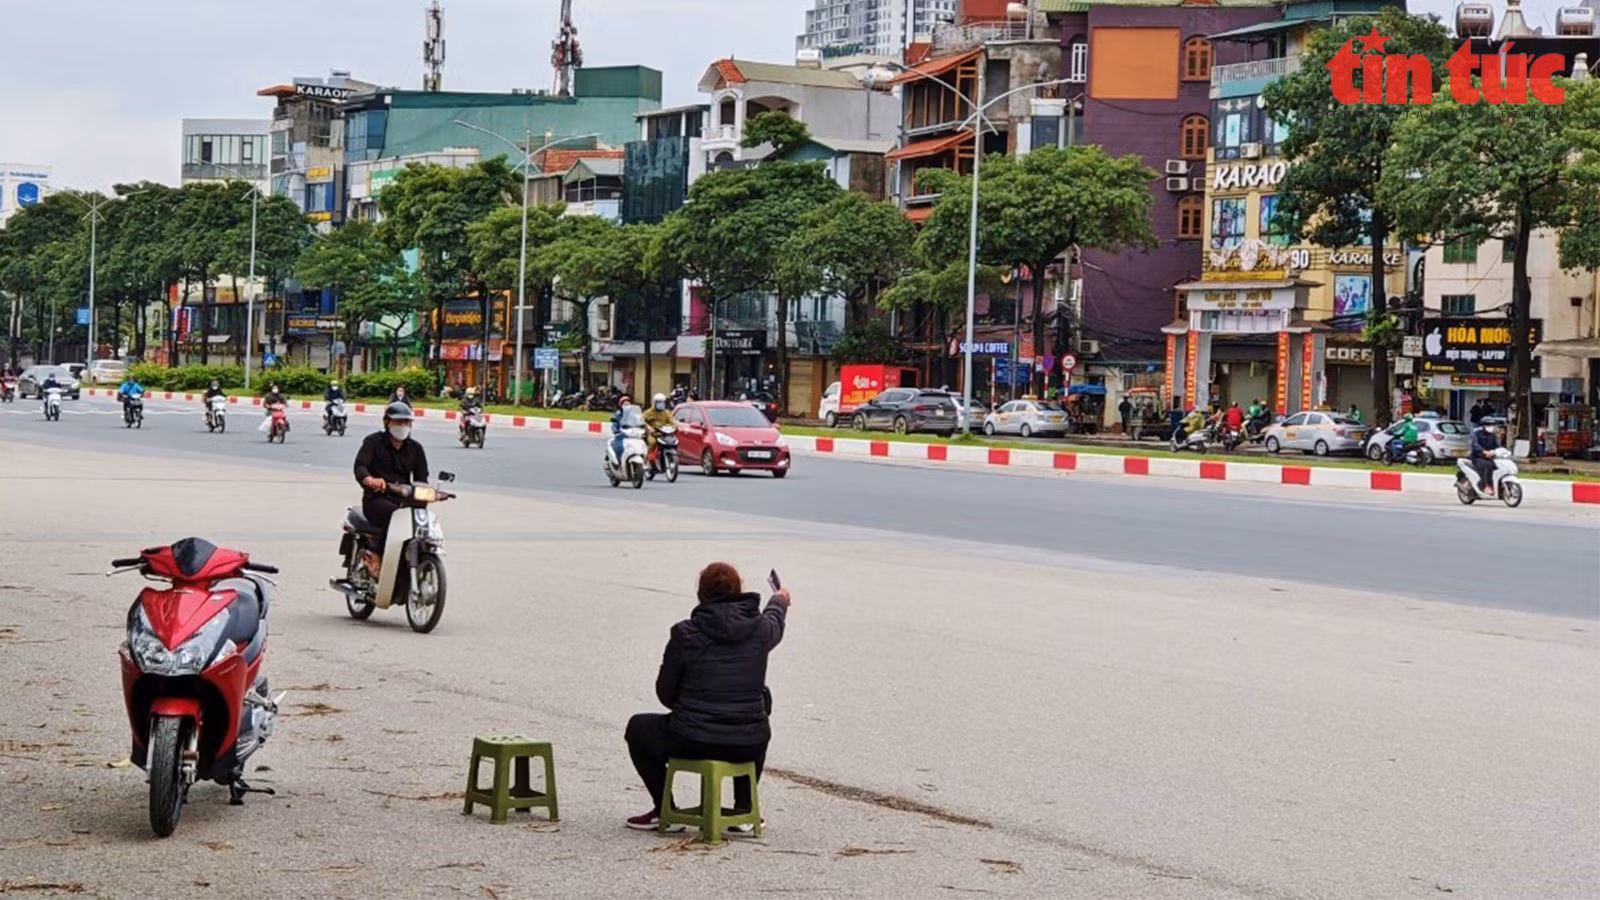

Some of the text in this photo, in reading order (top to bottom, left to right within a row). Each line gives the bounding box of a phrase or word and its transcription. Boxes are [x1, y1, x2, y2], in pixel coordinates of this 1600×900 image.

[296, 84, 350, 99] KARAOK
[1213, 162, 1286, 190] KARAO
[1291, 249, 1310, 269] 90
[1329, 251, 1402, 265] KARAKE
[1480, 326, 1536, 345] MOBE
[985, 342, 1009, 354] COFFEE
[1326, 347, 1394, 361] COFFE
